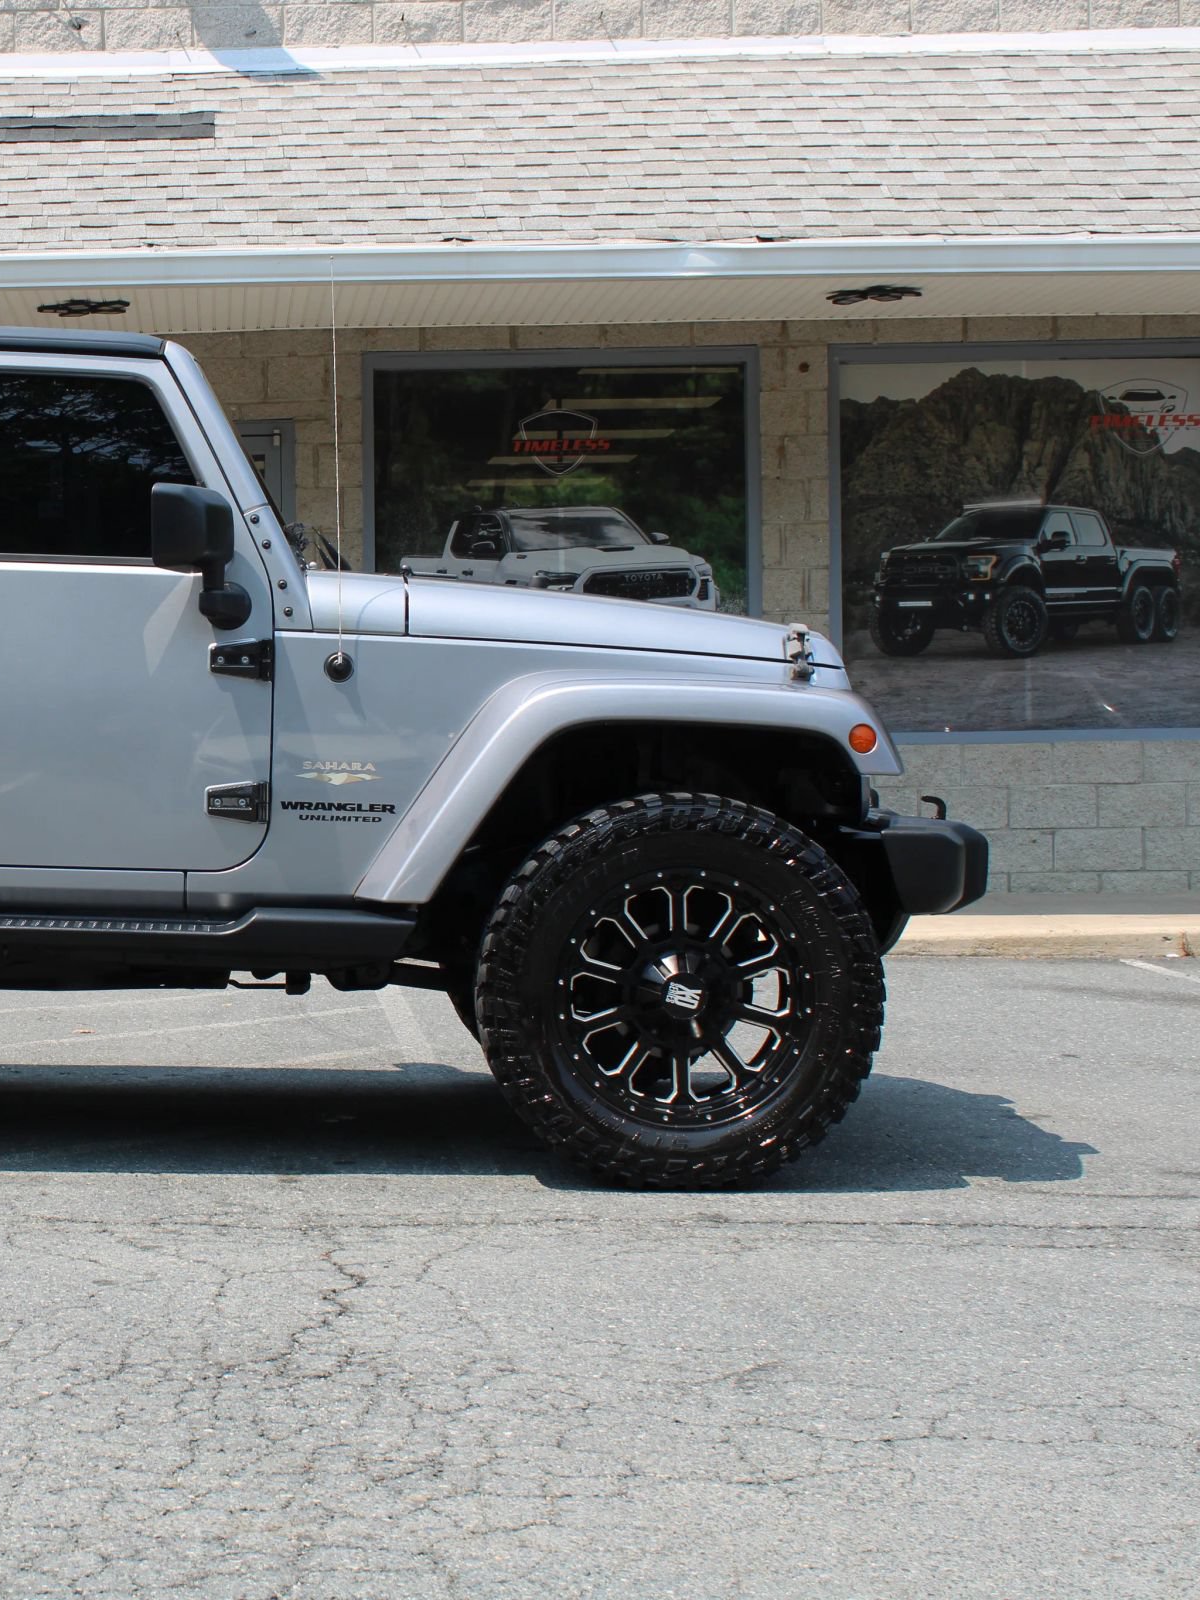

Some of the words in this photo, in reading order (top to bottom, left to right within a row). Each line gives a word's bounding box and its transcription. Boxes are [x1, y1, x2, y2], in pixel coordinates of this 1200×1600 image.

[512, 439, 610, 453] TIMELESS
[623, 573, 664, 582] TOYOTA
[302, 761, 376, 771] SAHARA
[280, 801, 396, 814] WRANGLER
[299, 814, 382, 823] UNLIMITED
